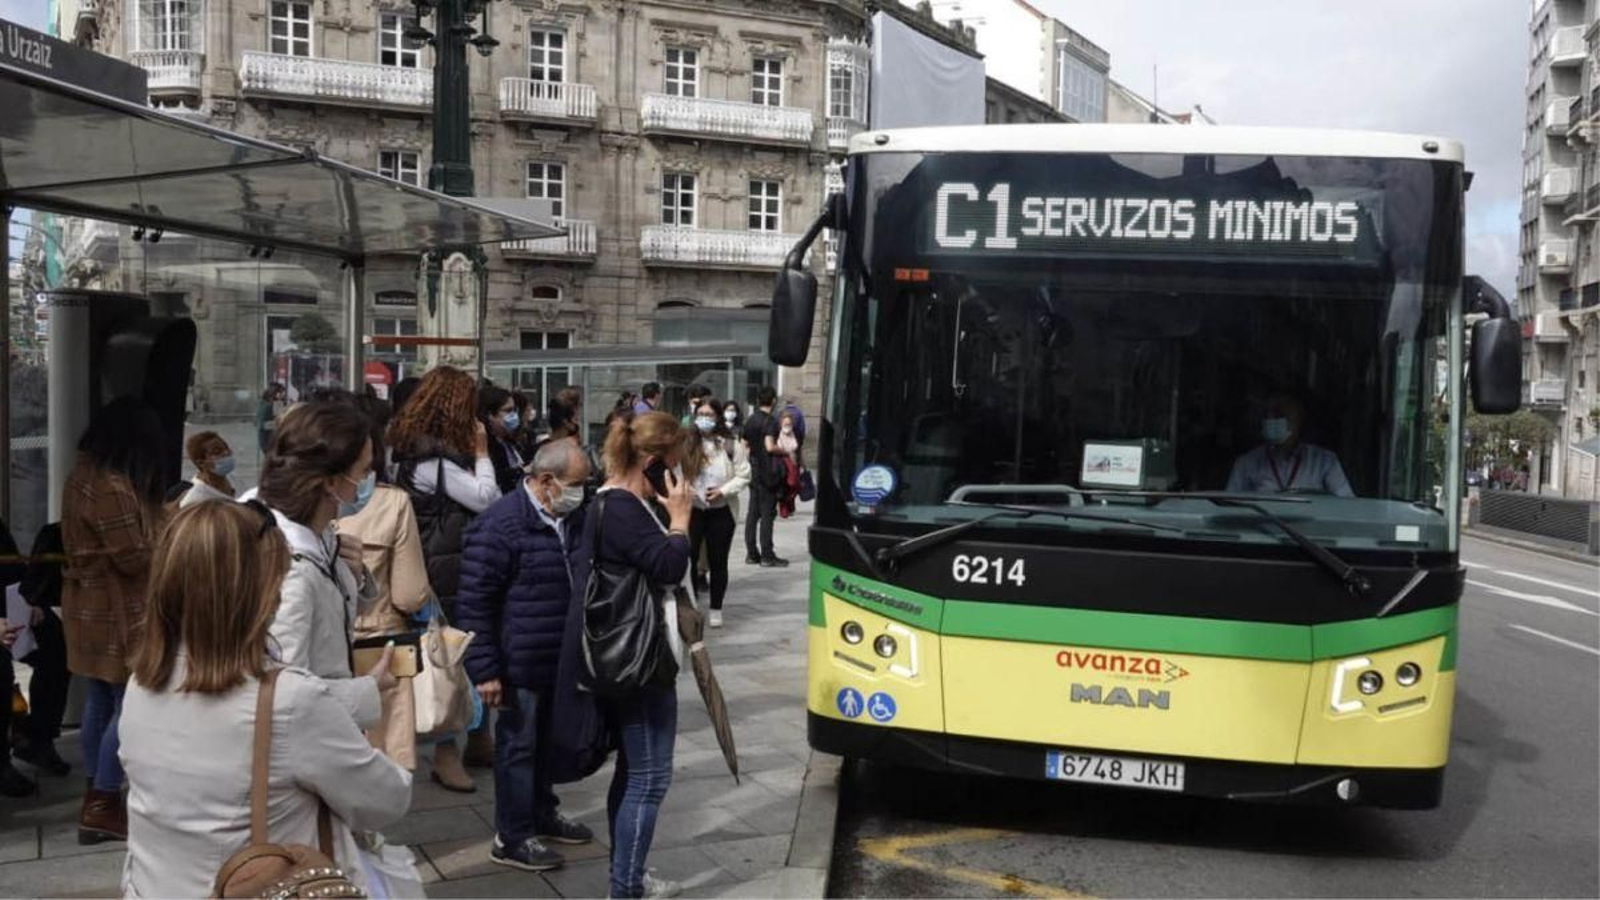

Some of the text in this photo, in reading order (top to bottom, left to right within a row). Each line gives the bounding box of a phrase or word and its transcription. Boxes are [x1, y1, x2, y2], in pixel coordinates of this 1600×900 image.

[8, 25, 52, 69] Urzaiz
[935, 183, 1359, 249] C1 SERVIZOS MINIMOS
[952, 554, 1026, 587] 6214
[1056, 650, 1161, 675] avanza
[1070, 682, 1171, 710] MAN
[1062, 755, 1178, 787] 6748 JKH
